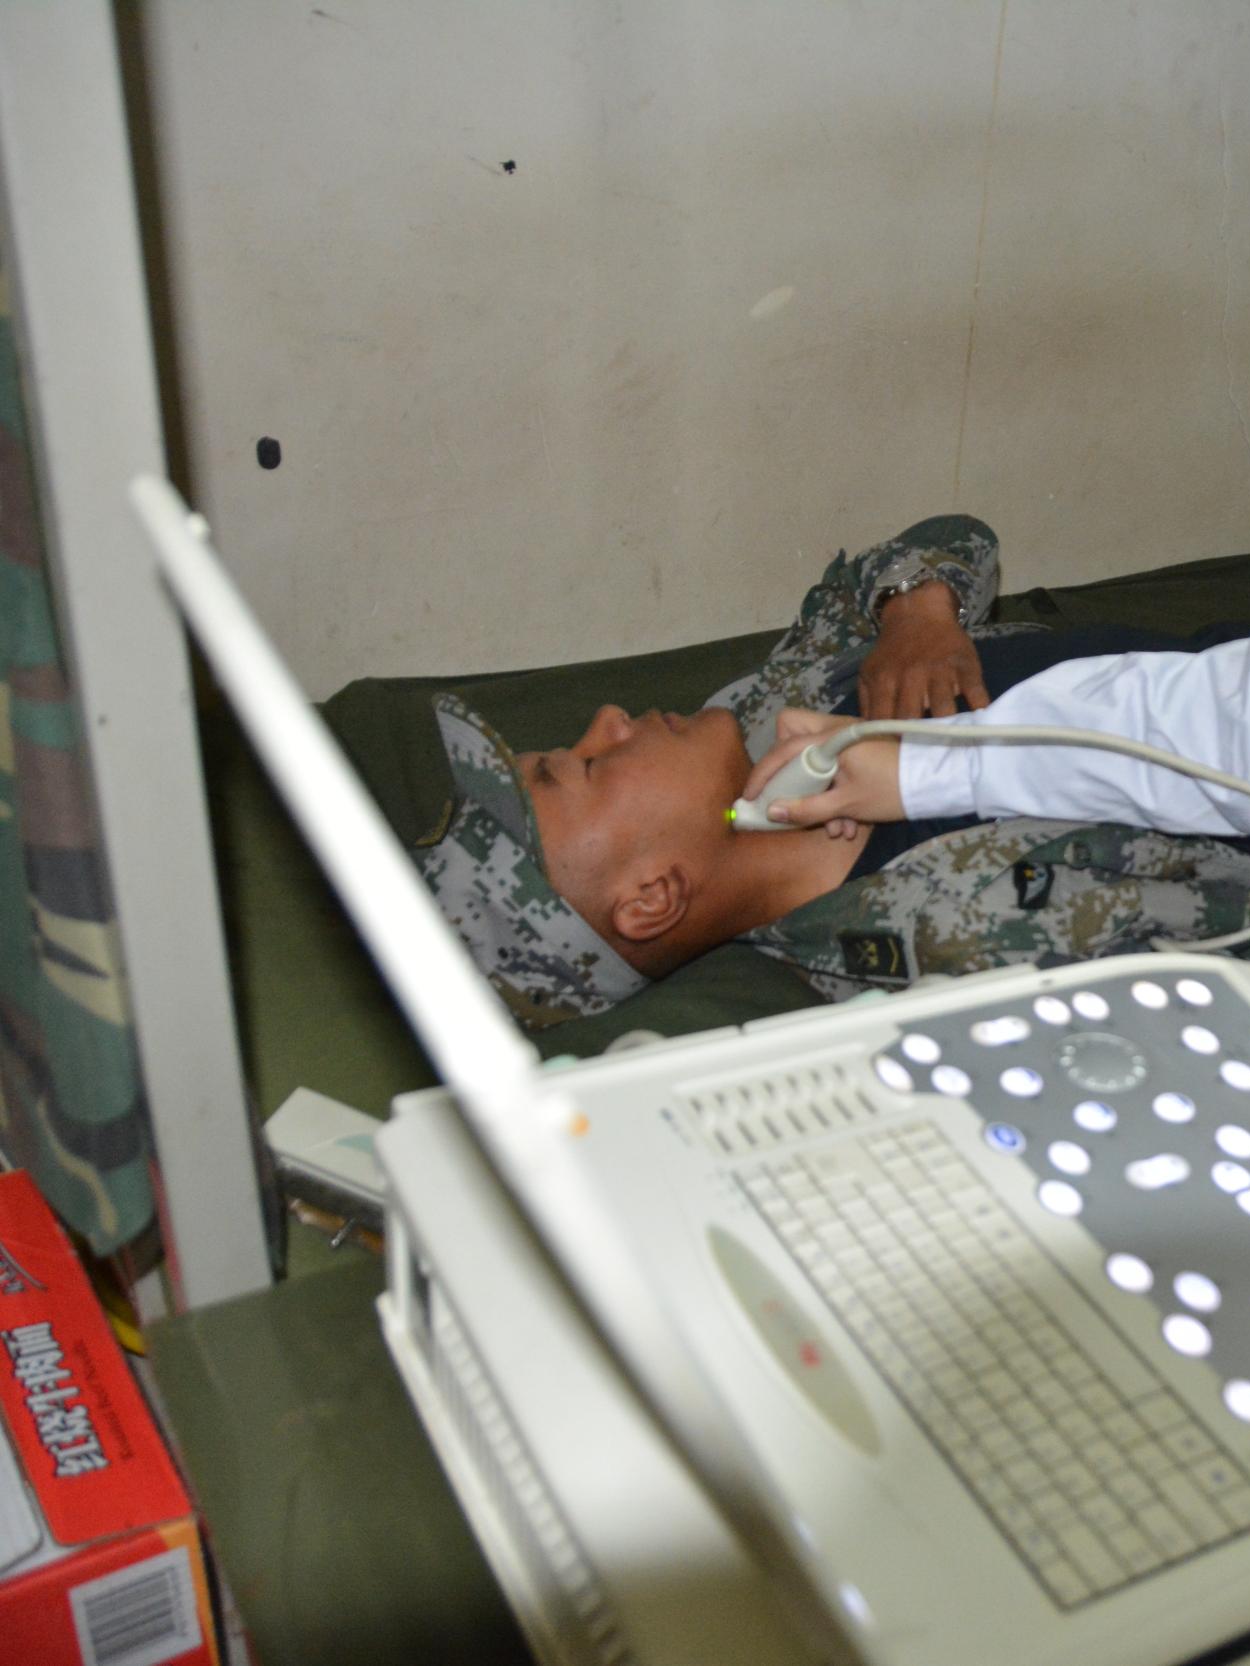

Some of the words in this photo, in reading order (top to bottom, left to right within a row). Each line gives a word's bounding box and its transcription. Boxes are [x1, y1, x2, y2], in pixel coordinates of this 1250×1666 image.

[2, 1322, 109, 1477] 红烧牛肉面
